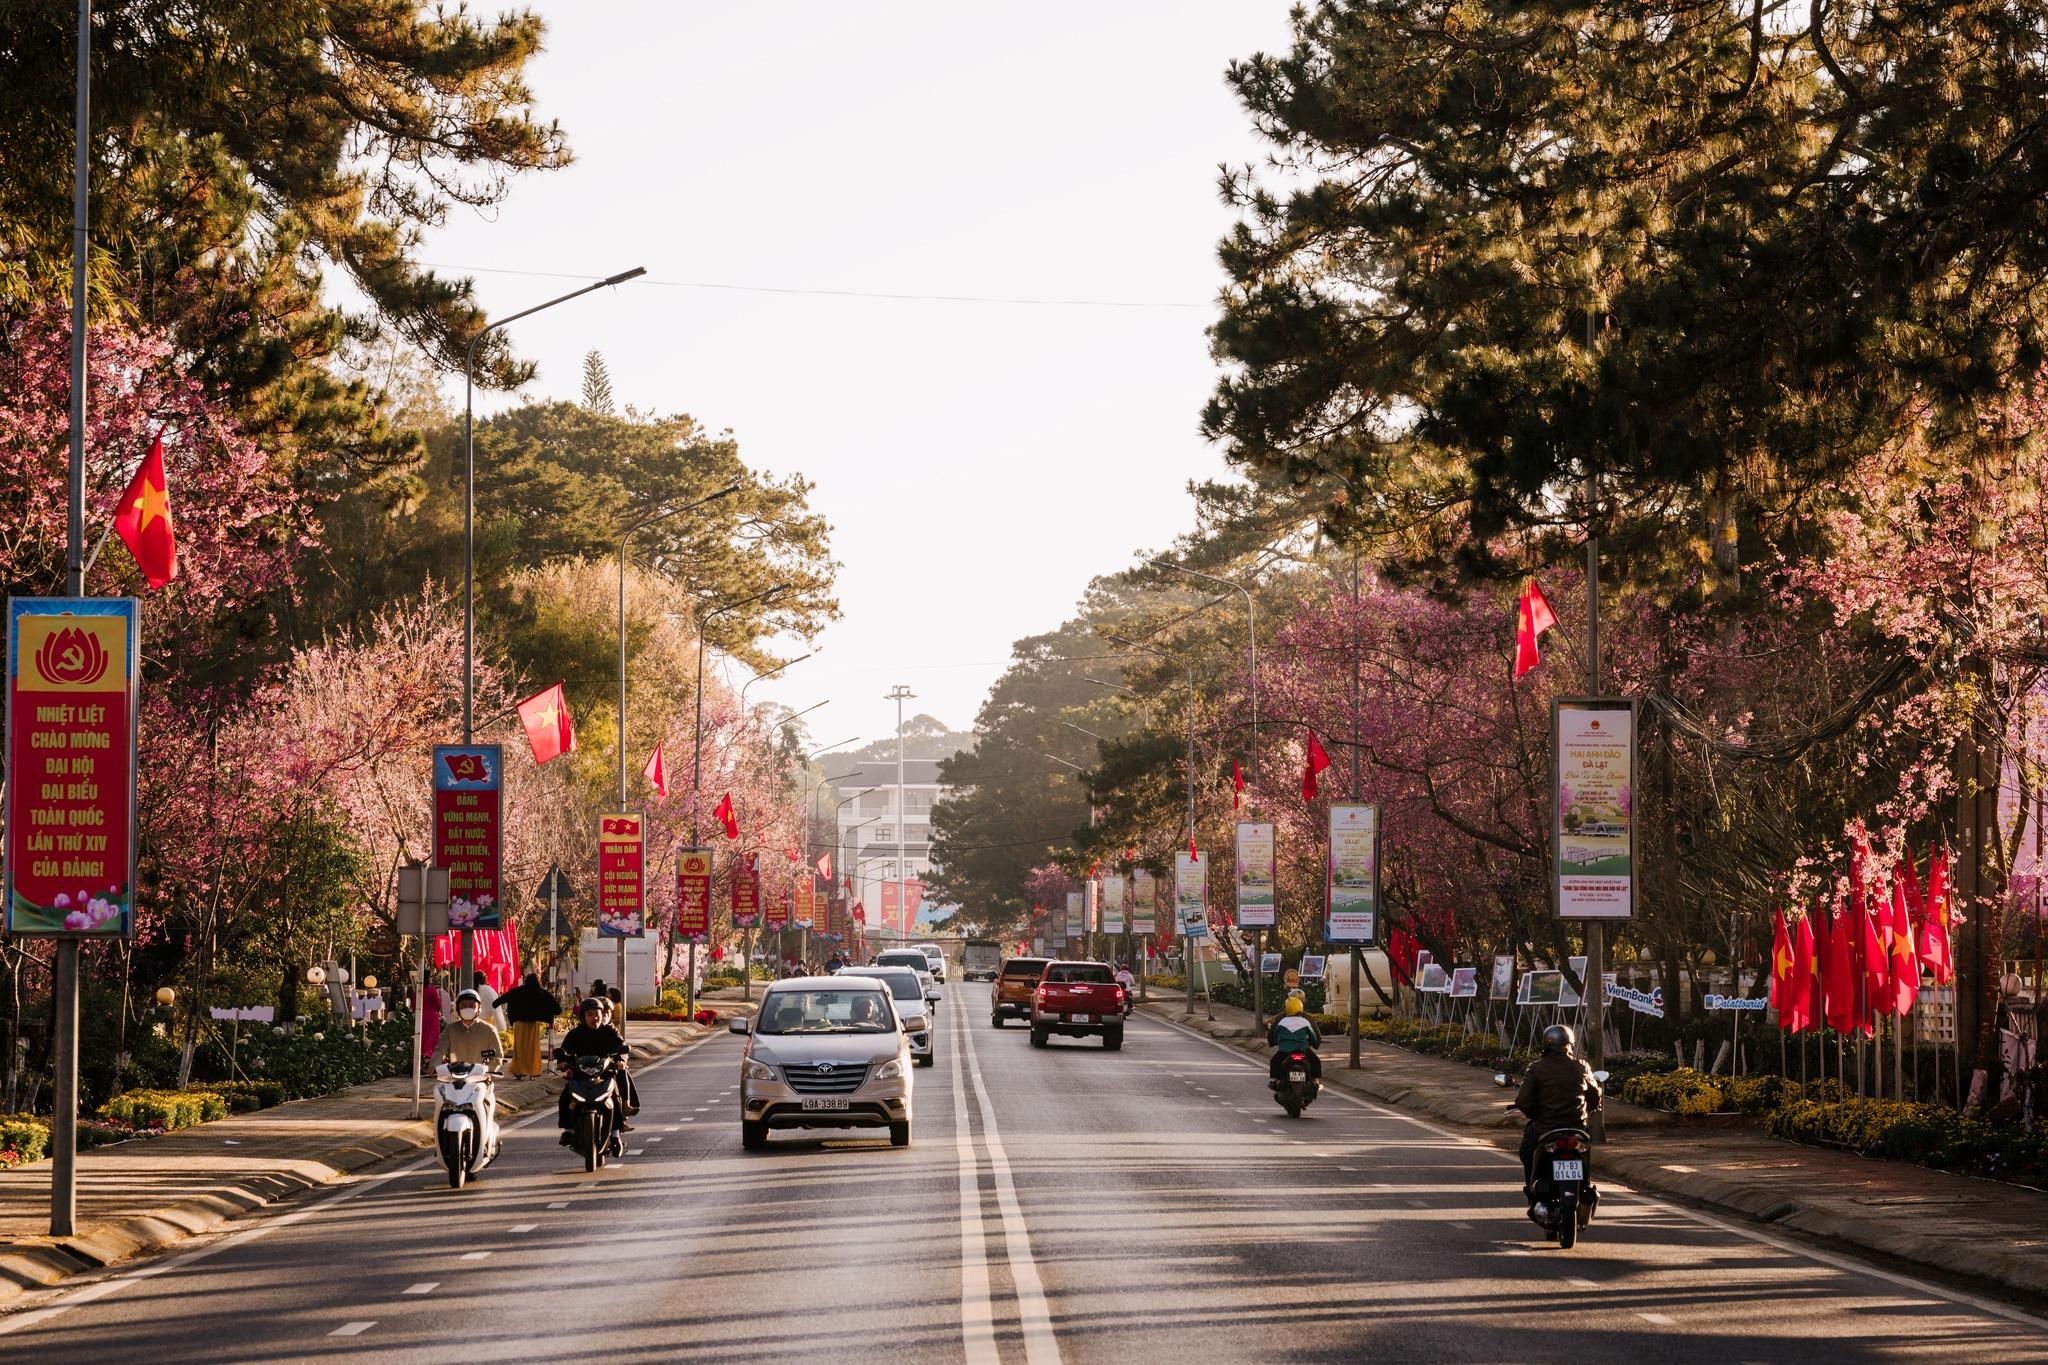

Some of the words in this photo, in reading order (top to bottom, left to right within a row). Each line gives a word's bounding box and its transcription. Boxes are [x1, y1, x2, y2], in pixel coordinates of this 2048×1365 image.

[36, 704, 75, 726] NHIỆT
[78, 704, 105, 726] LIỆT
[31, 730, 66, 749] CHÀO
[70, 730, 110, 749] MỪNG
[1569, 751, 1585, 759] MAI
[1586, 751, 1602, 759] ANH
[45, 758, 68, 778] ĐẠI
[72, 755, 94, 778] HỘI
[1582, 760, 1593, 769] ĐÀ
[1595, 761, 1608, 770] LẠT
[41, 783, 64, 803] ĐẠI
[68, 778, 98, 800] BIỂU
[456, 792, 478, 806] ĐẢNG
[30, 806, 65, 826] TOÀN
[69, 805, 104, 827] QUỐC
[443, 810, 464, 823] VỮNG
[466, 811, 491, 824] MẠNH,
[448, 825, 463, 839] ĐẤT
[465, 826, 486, 839] NƯỚC
[27, 830, 53, 851] LẦN
[57, 831, 83, 851] THỨ
[85, 835, 107, 851] XIV
[444, 844, 464, 855] PHÁT
[466, 841, 490, 856] TRIỂN,
[605, 844, 622, 854] NHÂN
[32, 856, 59, 877] CỦA
[62, 856, 104, 877] ĐẢNG!
[469, 861, 484, 874] TỘC
[617, 857, 625, 867] LÀ
[616, 869, 638, 880] NGUỒN
[450, 876, 473, 889] ƯỜNG
[475, 876, 492, 889] TỒN!
[604, 883, 617, 894] SỨC
[618, 884, 637, 895] MẠNH
[605, 895, 618, 907] CỦA
[619, 895, 638, 907] ĐẢNG!
[1607, 984, 1654, 1006] VietinBank
[1714, 995, 1766, 1010] Dalattourist
[803, 1099, 848, 1109] 49A-338.89
[1557, 1161, 1578, 1170] 71-B3
[1555, 1171, 1581, 1179] 014.04
